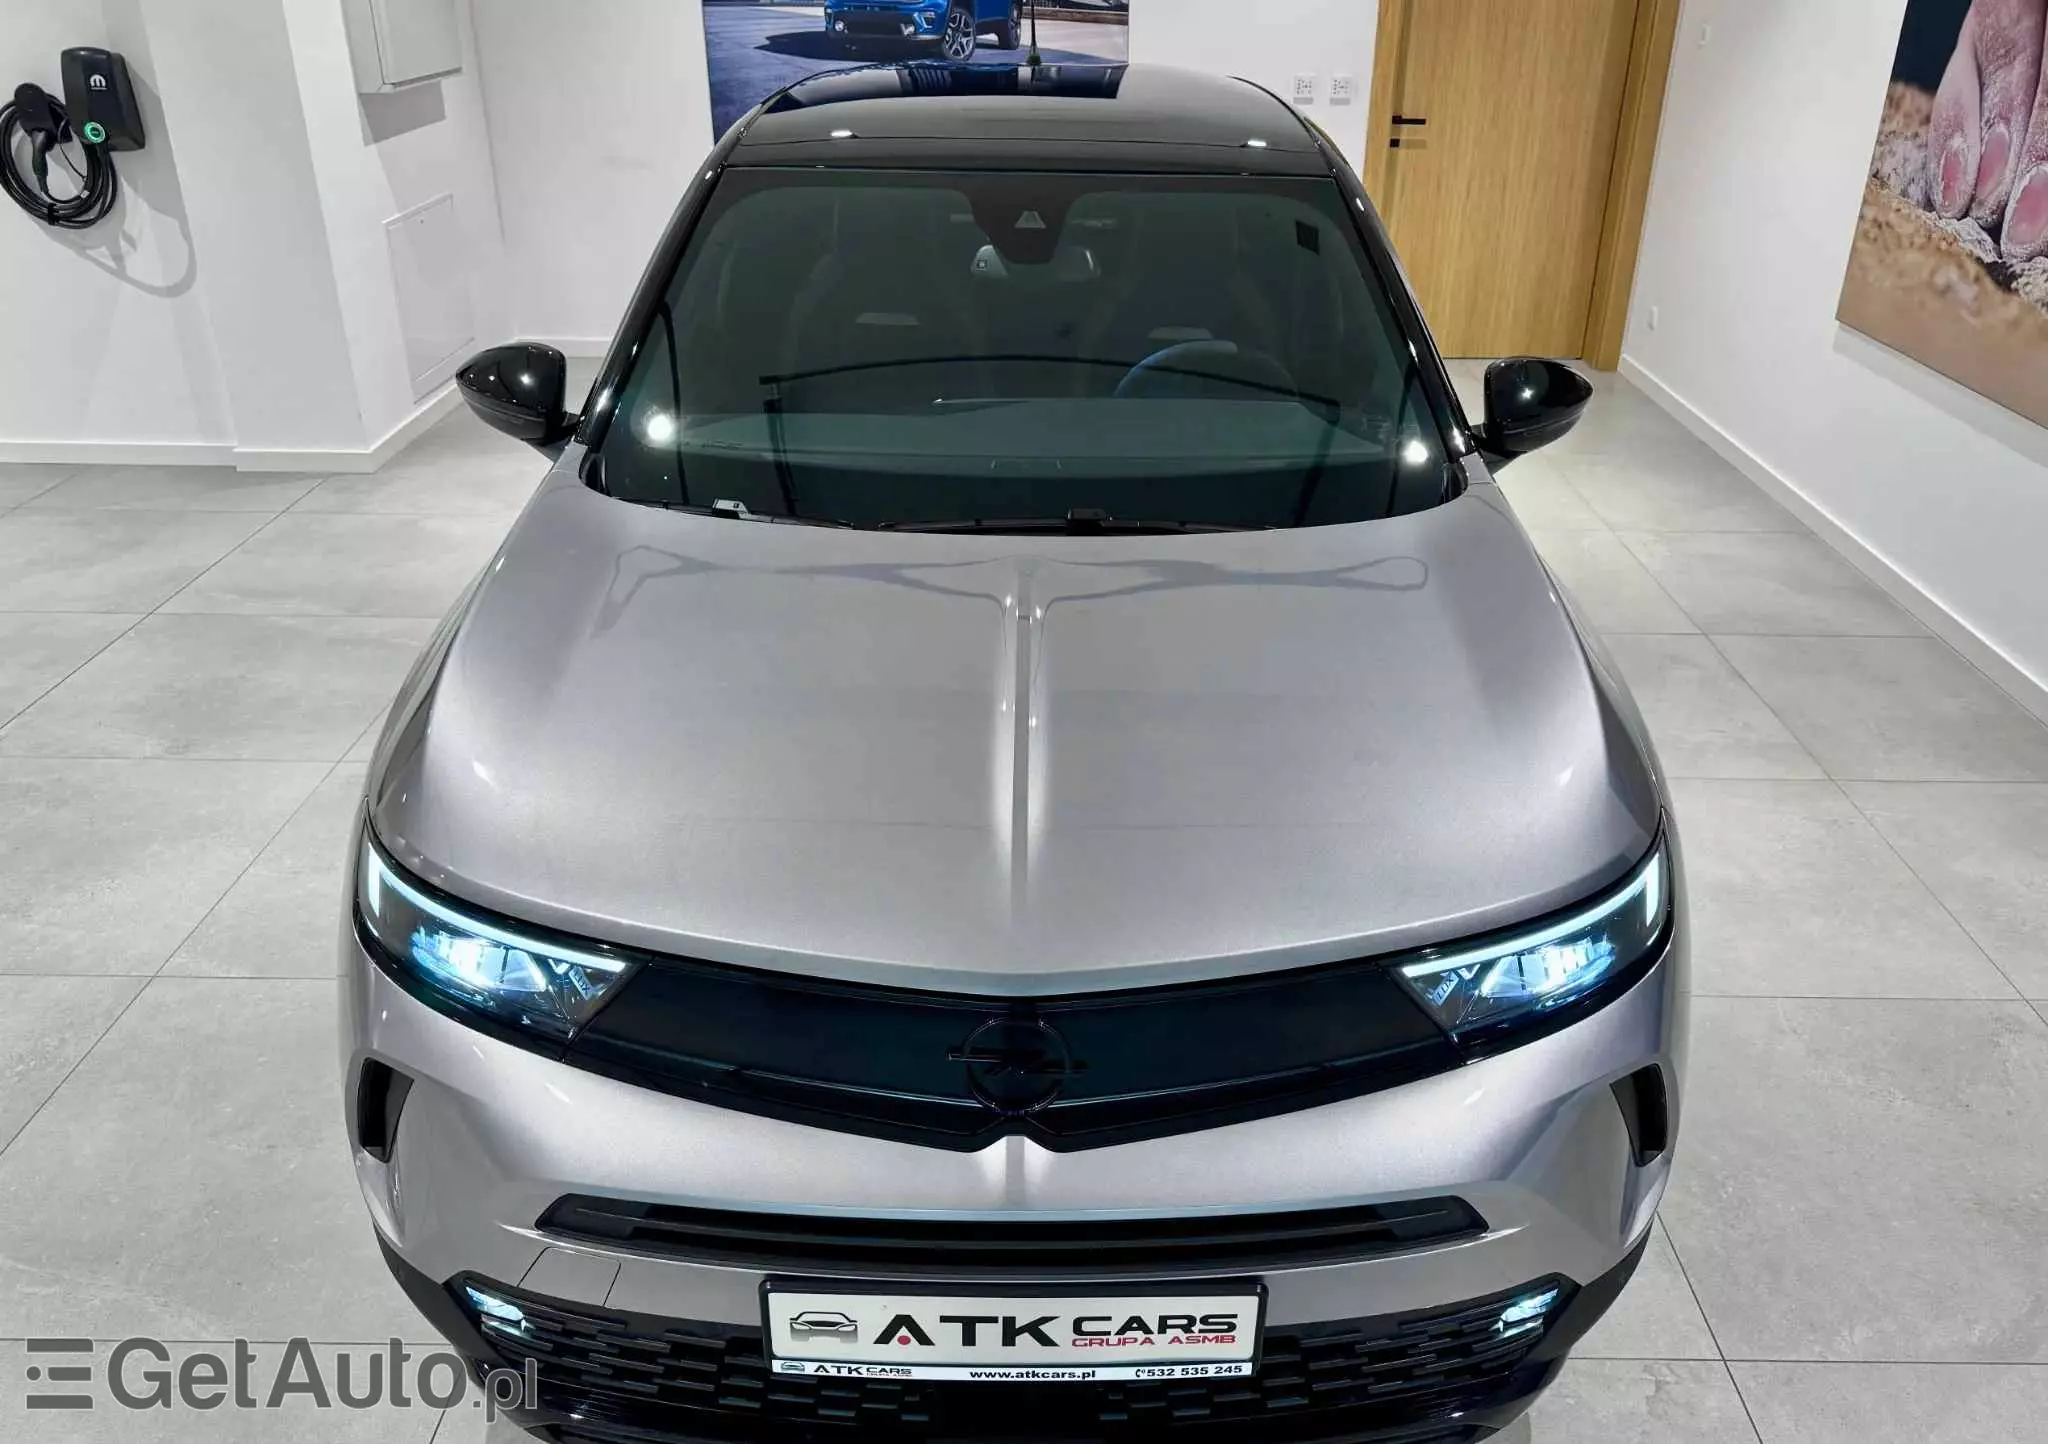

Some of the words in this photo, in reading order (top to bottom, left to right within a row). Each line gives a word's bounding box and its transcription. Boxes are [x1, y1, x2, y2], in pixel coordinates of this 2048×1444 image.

[873, 1314, 1060, 1347] ATK
[1072, 1314, 1238, 1336] CARS
[1071, 1336, 1156, 1347] GRUPA
[1168, 1335, 1237, 1345] ASMB
[813, 1364, 864, 1376] ATK
[866, 1367, 912, 1375] CARS
[969, 1369, 1096, 1380] www.atkcars.pl
[1146, 1368, 1176, 1377] 532
[1180, 1366, 1209, 1376] 535
[1213, 1365, 1243, 1375] 245
